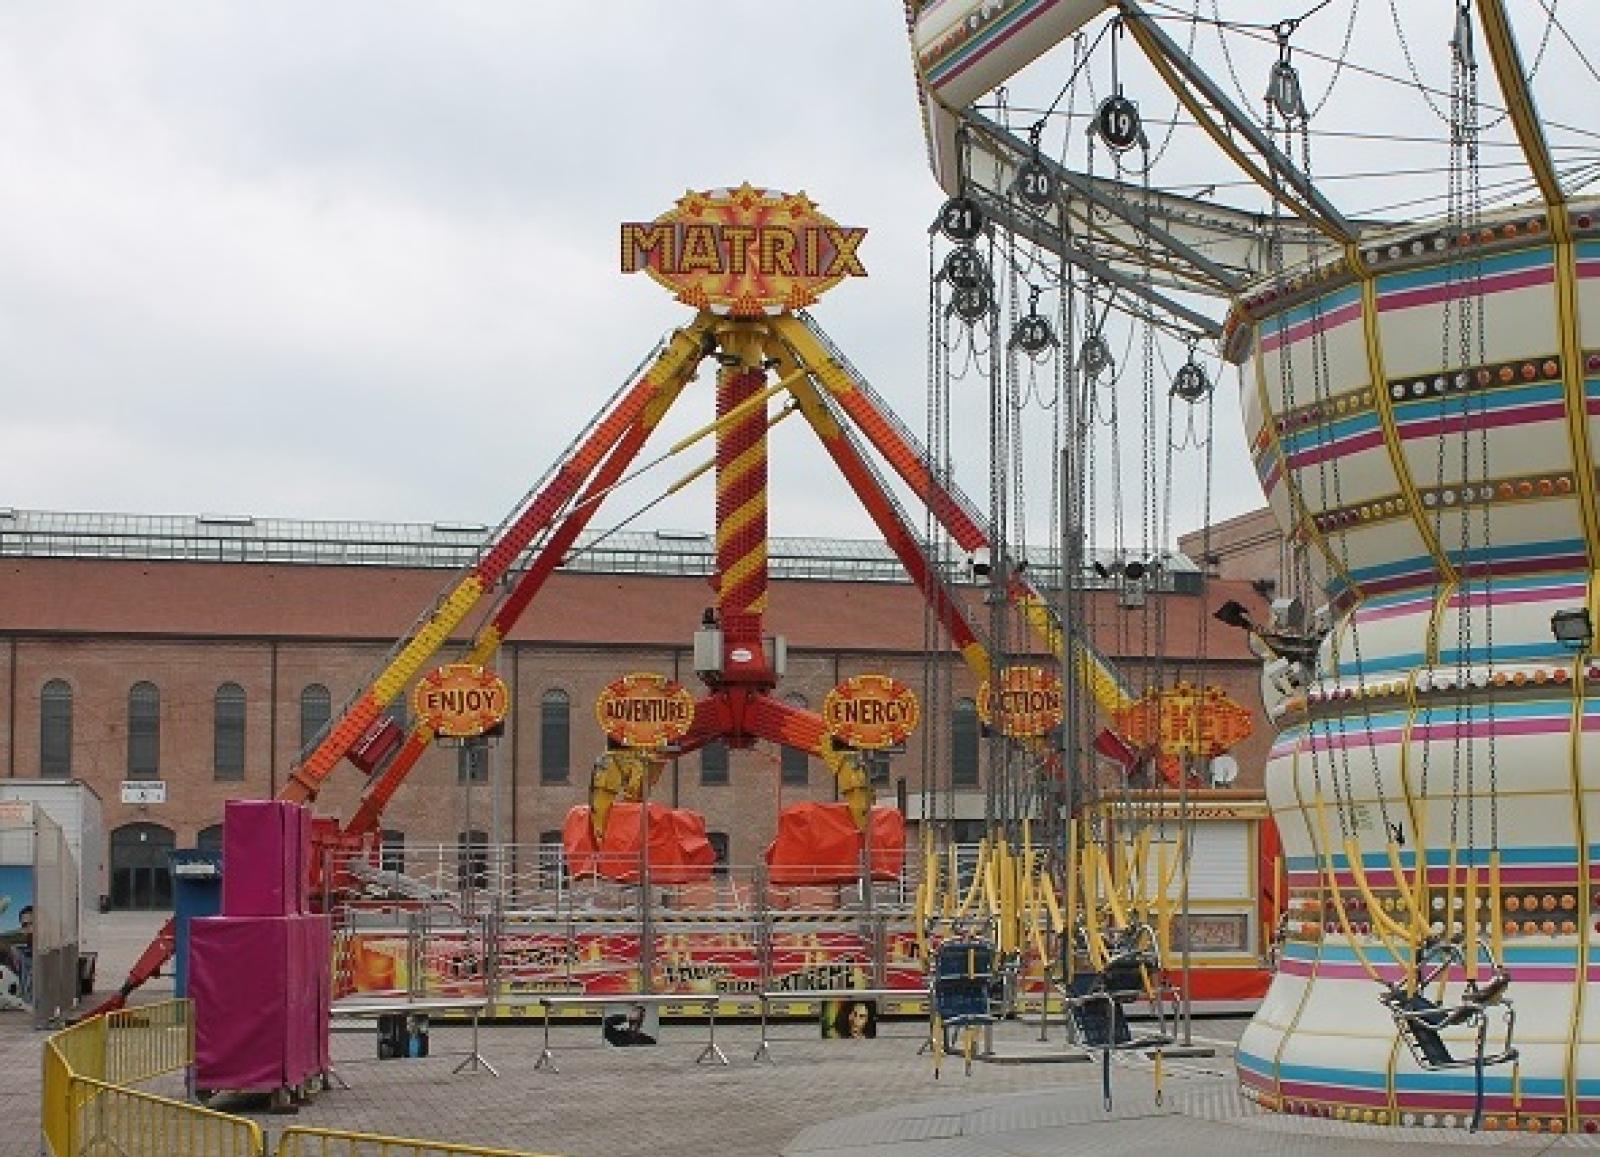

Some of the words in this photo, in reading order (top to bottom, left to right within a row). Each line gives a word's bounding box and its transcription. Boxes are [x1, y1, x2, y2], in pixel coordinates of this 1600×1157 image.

[1109, 112, 1129, 130] 19
[1026, 175, 1046, 194] 20
[948, 209, 972, 229] 21
[621, 222, 868, 277] MATRIX
[427, 690, 496, 715] ENJOY
[606, 699, 687, 722] ADVENTURE
[834, 700, 910, 726] ENERGY
